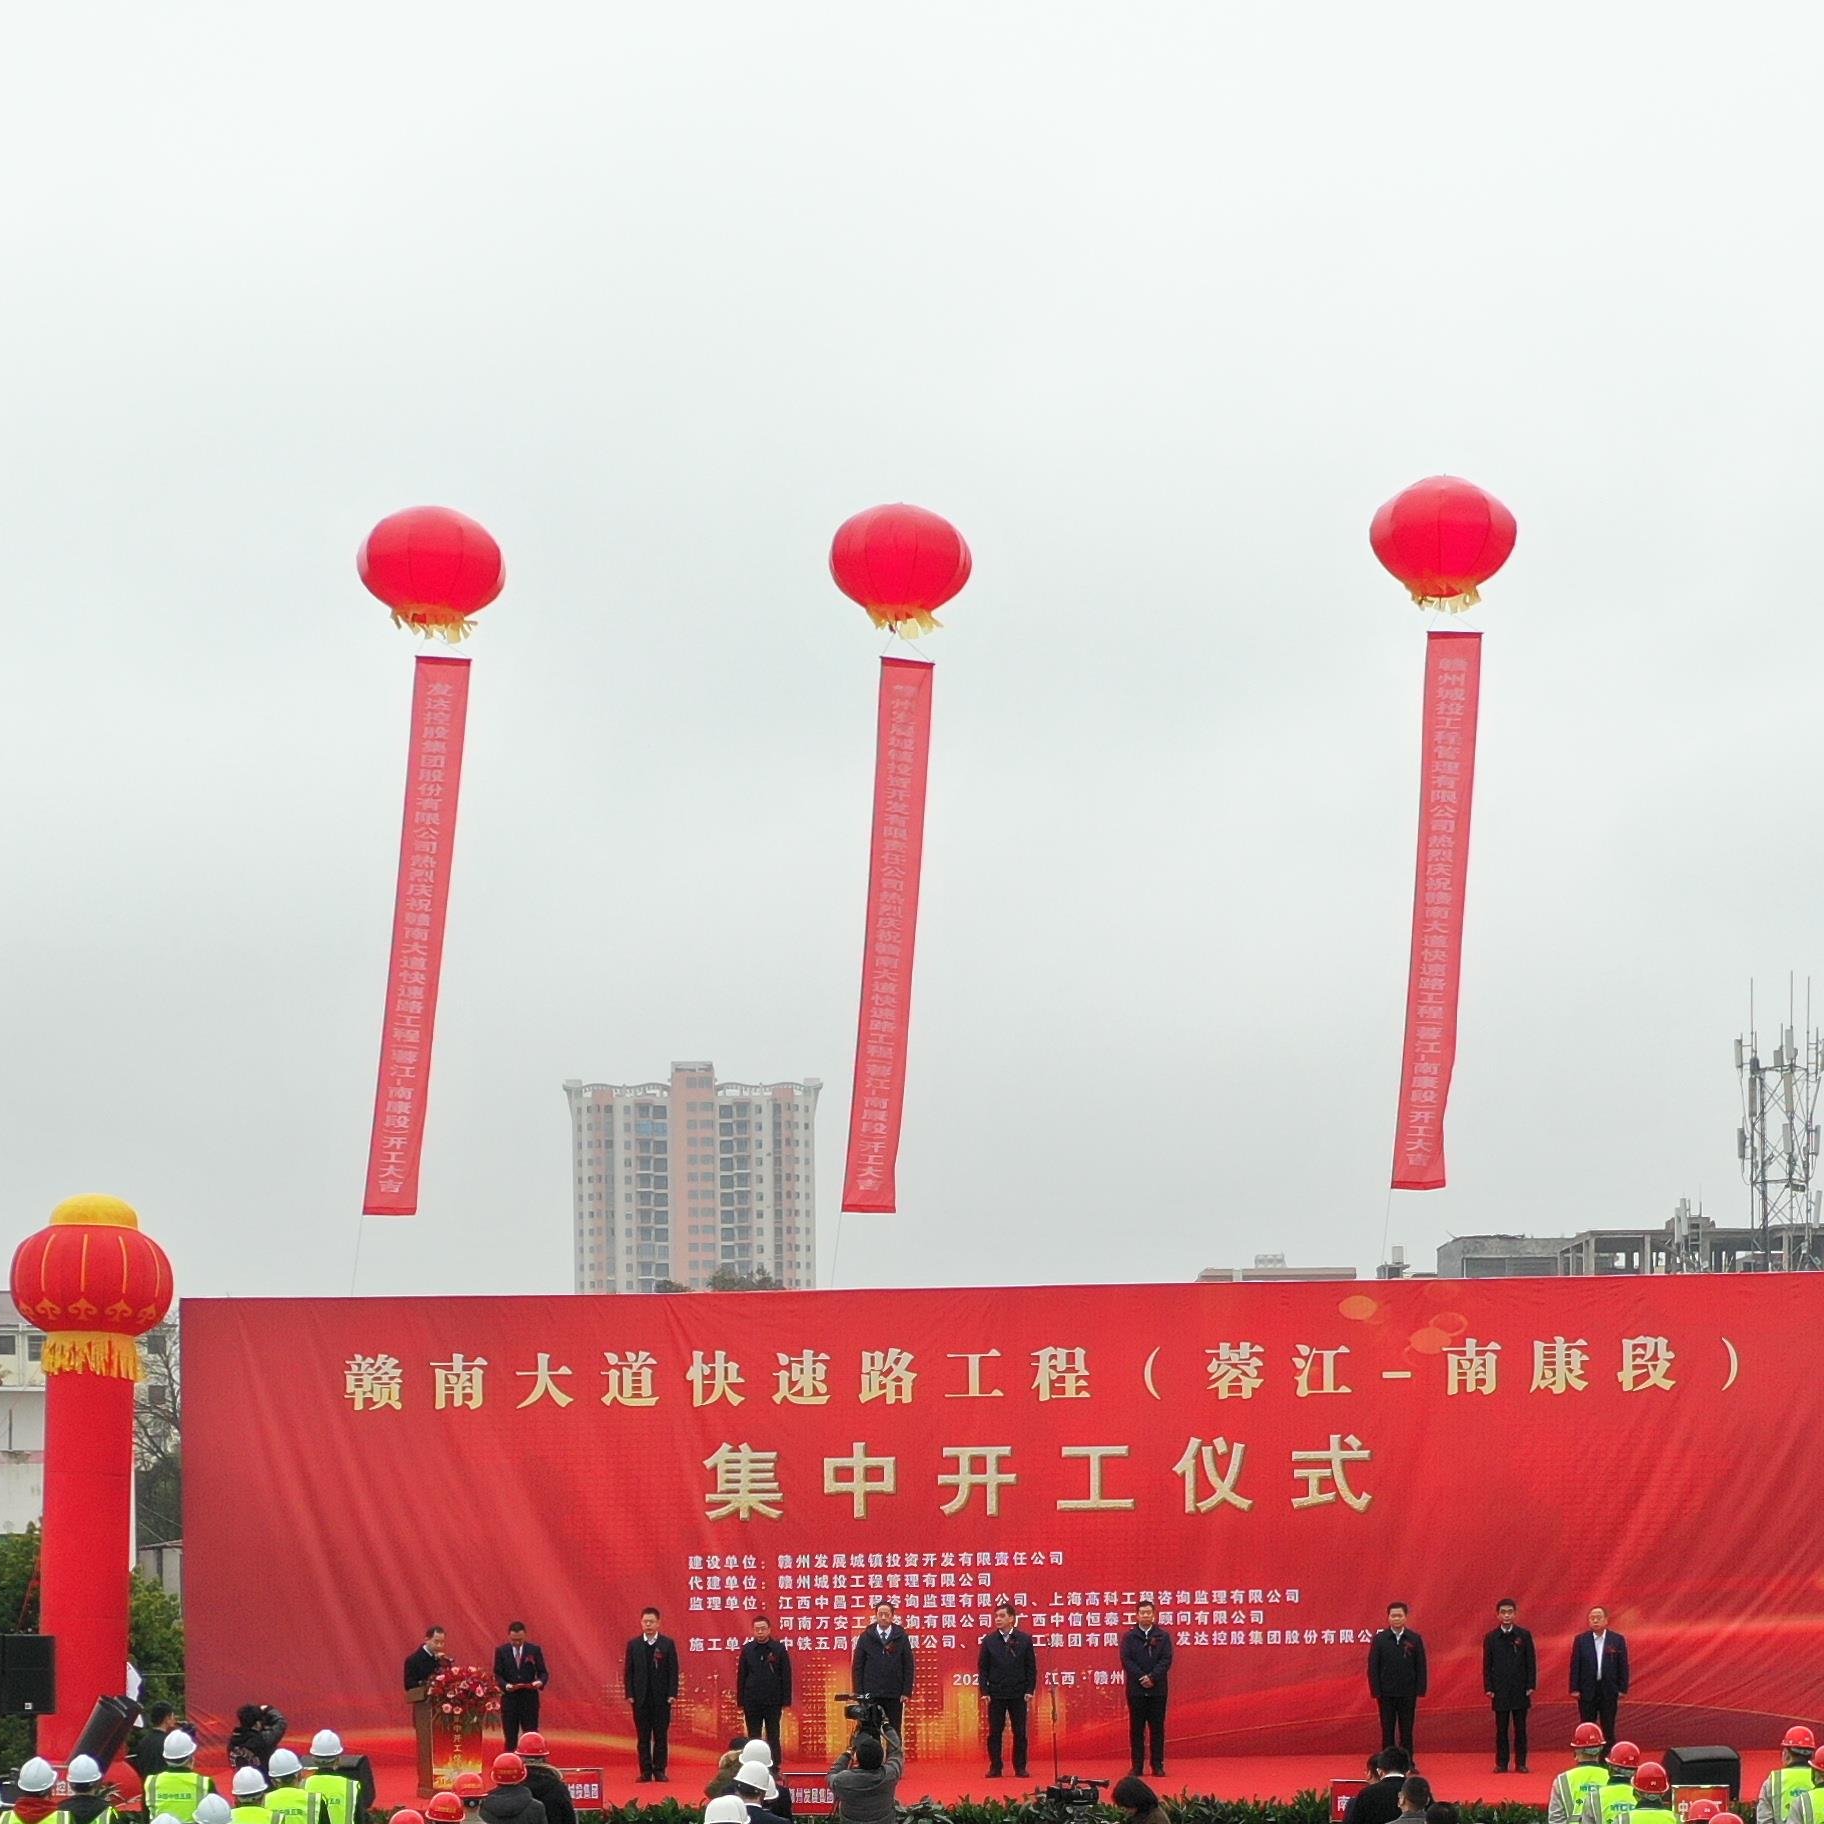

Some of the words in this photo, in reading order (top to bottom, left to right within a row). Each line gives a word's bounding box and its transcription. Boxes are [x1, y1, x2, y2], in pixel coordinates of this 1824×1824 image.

[702, 1433, 1373, 1522] 集中开工仪式
